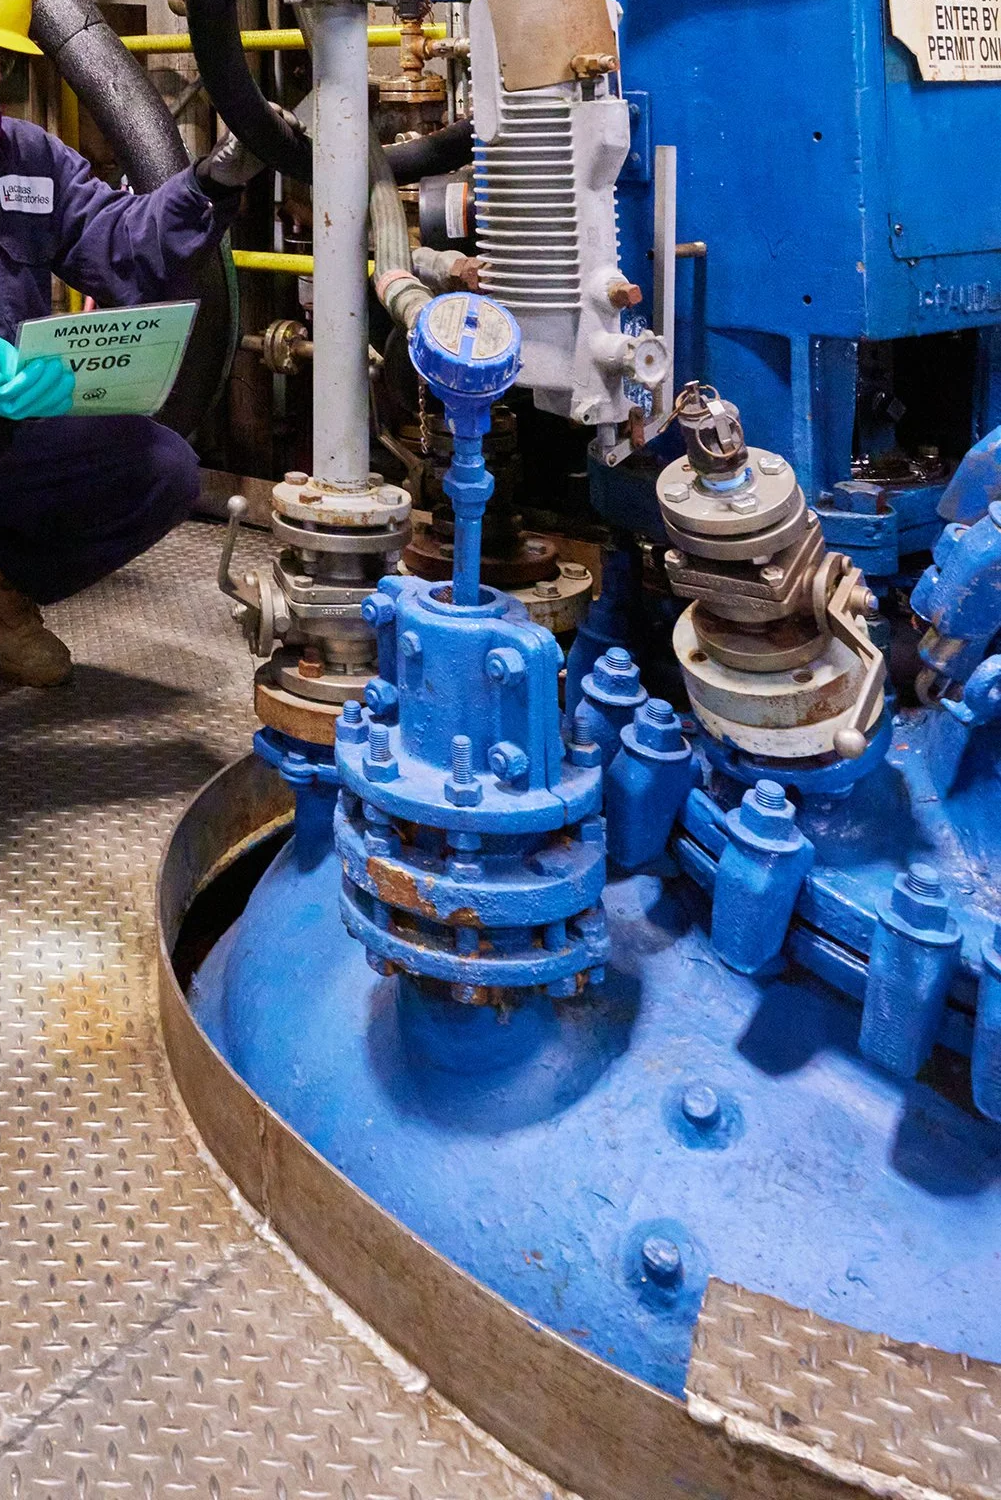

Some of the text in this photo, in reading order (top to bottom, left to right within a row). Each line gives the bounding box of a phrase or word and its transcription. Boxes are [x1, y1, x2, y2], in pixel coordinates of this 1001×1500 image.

[936, 5, 999, 31] ENTER BY
[928, 35, 976, 61] PERMIT
[54, 319, 161, 338] MANWAY OK
[67, 334, 142, 349] TO OPEN
[69, 354, 132, 373] V506
